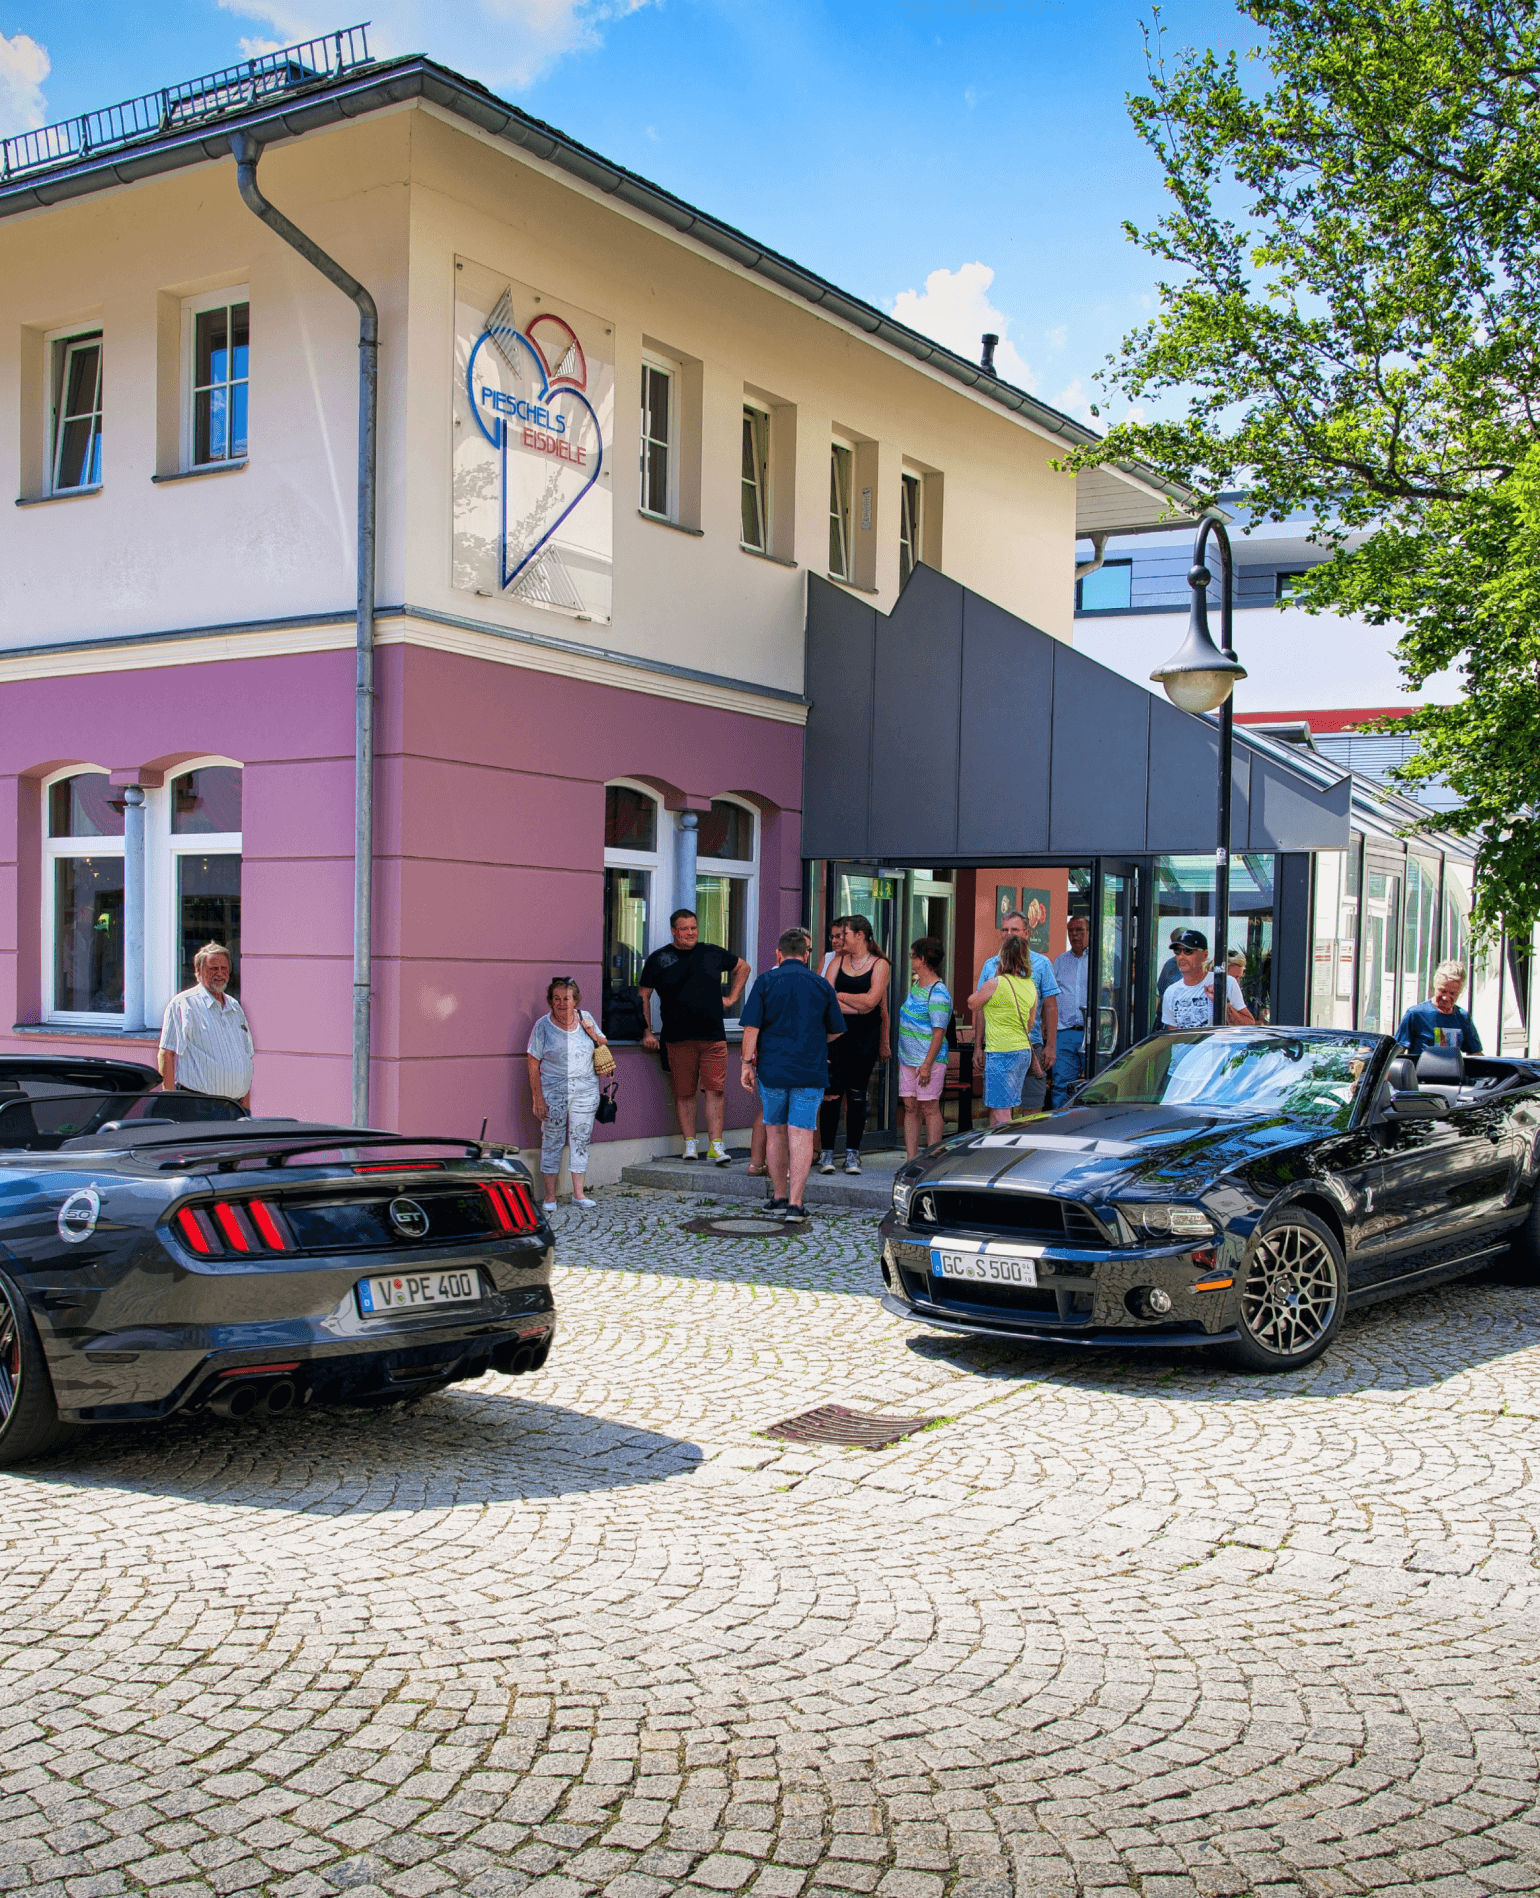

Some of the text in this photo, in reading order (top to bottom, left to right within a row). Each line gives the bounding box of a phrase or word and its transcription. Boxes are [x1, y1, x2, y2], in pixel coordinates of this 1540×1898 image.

[482, 386, 566, 434] PIESCHELS
[523, 427, 587, 467] EISDIELE
[396, 1212, 421, 1222] GT
[942, 1255, 1022, 1282] GC S 500
[378, 1273, 472, 1306] V PE 400
